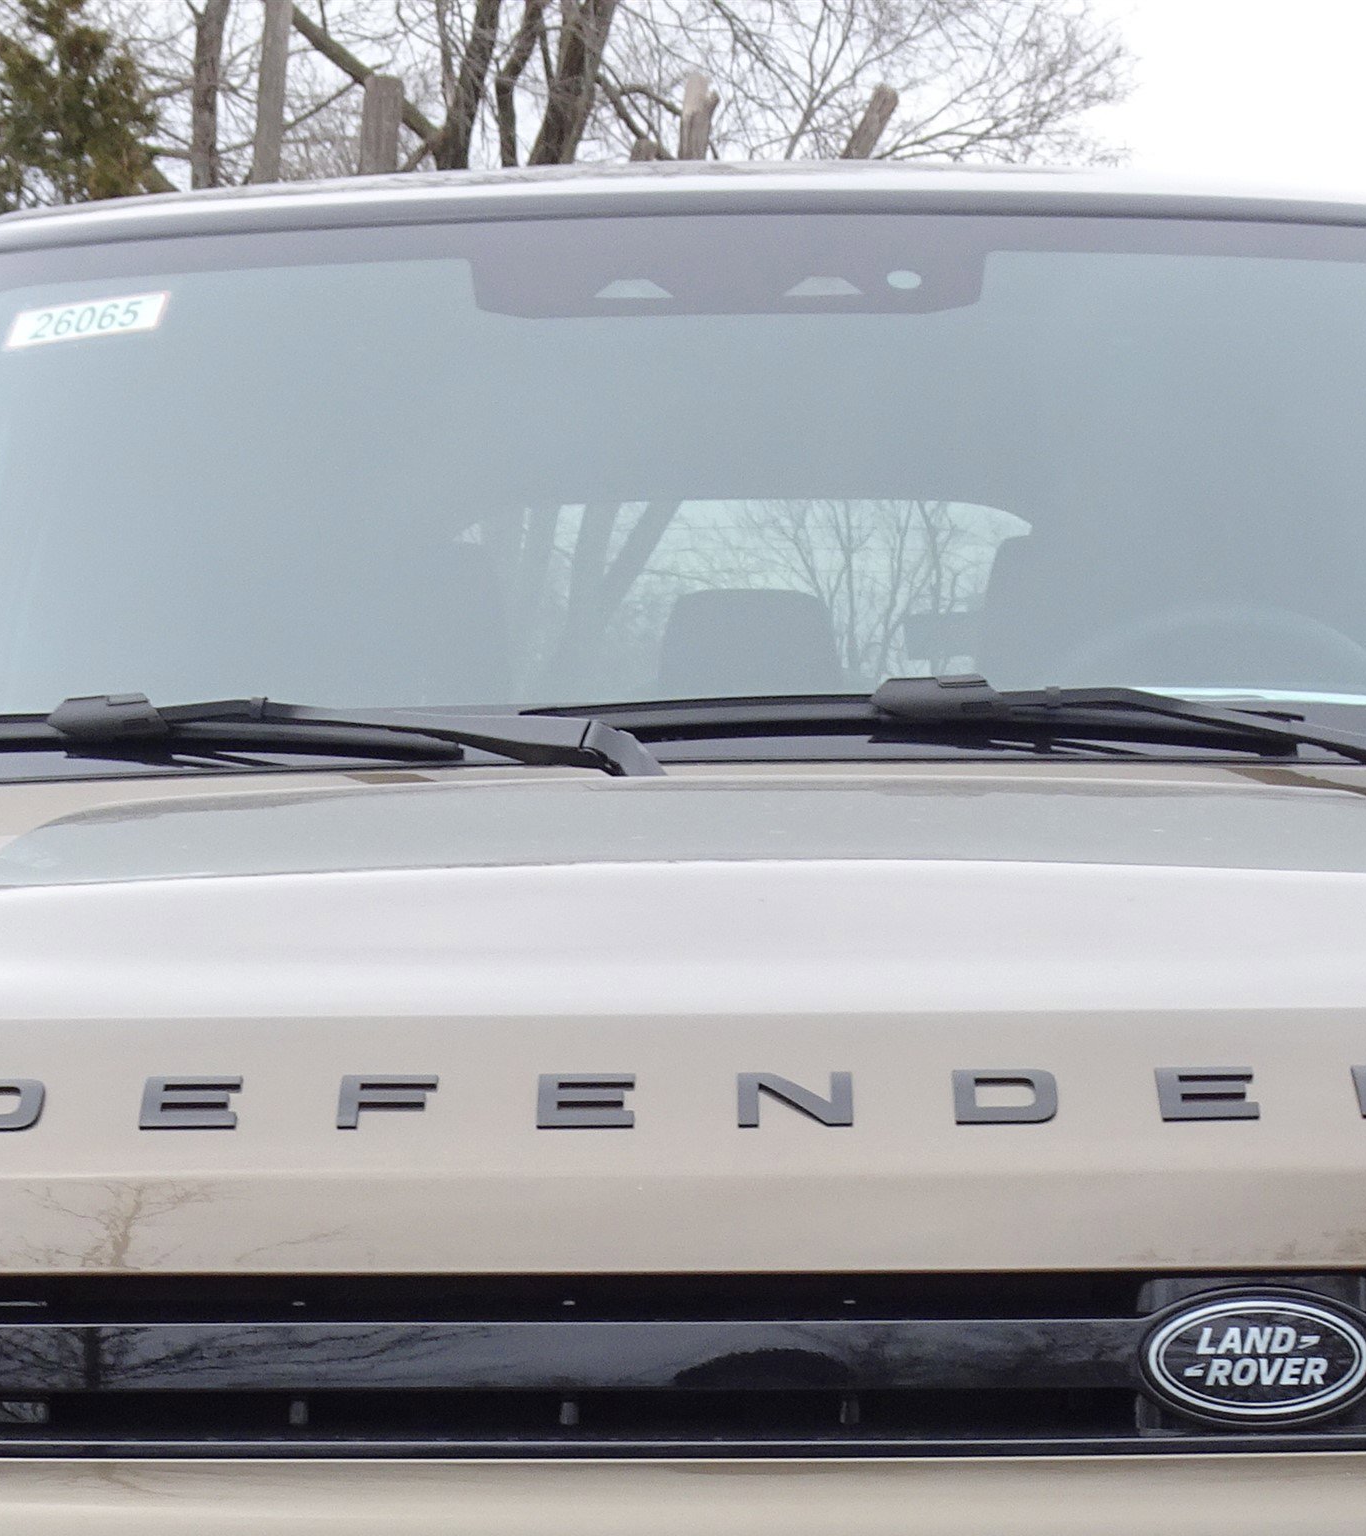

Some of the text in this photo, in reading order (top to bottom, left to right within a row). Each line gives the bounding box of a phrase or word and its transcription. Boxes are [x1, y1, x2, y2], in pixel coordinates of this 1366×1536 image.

[28, 300, 143, 340] 26065
[1196, 1326, 1298, 1355] LAND
[1204, 1357, 1329, 1387] ROVER
